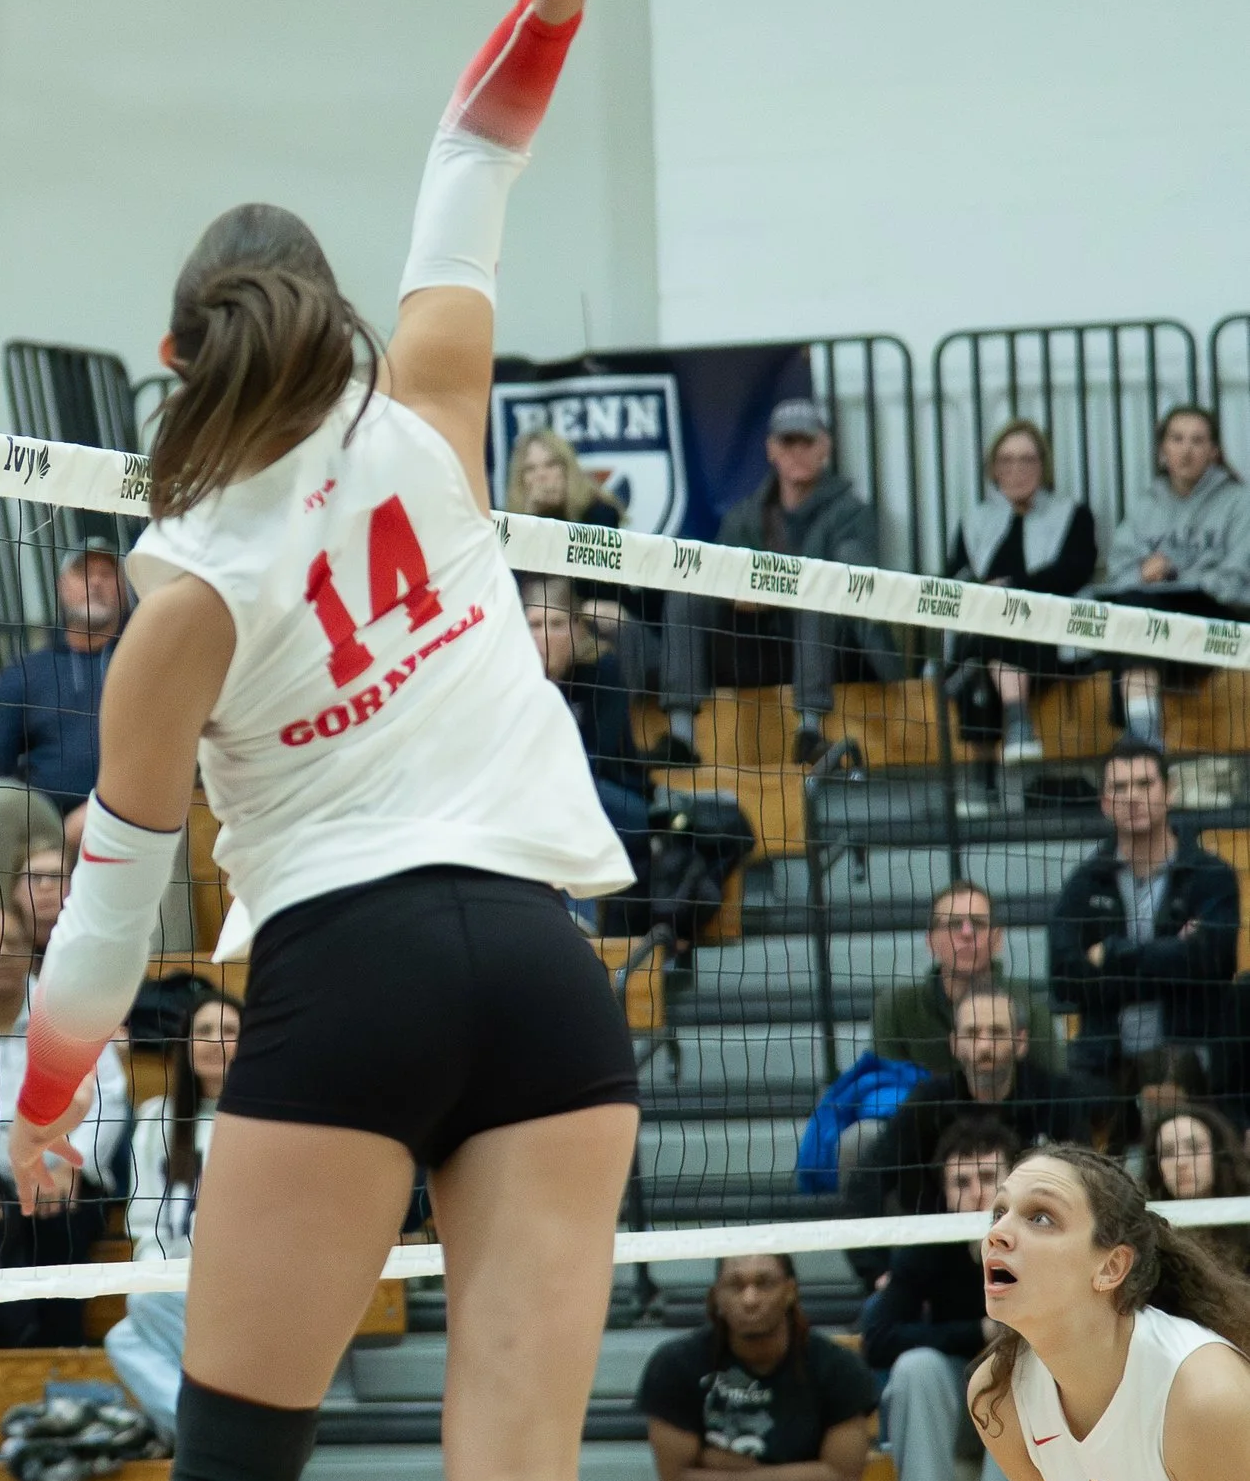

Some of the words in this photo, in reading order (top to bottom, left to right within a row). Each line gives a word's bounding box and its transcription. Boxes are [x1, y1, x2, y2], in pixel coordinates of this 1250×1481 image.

[3, 436, 37, 484] Ivy
[512, 394, 662, 441] PENN
[304, 492, 444, 689] 14
[279, 604, 485, 748] CORN
